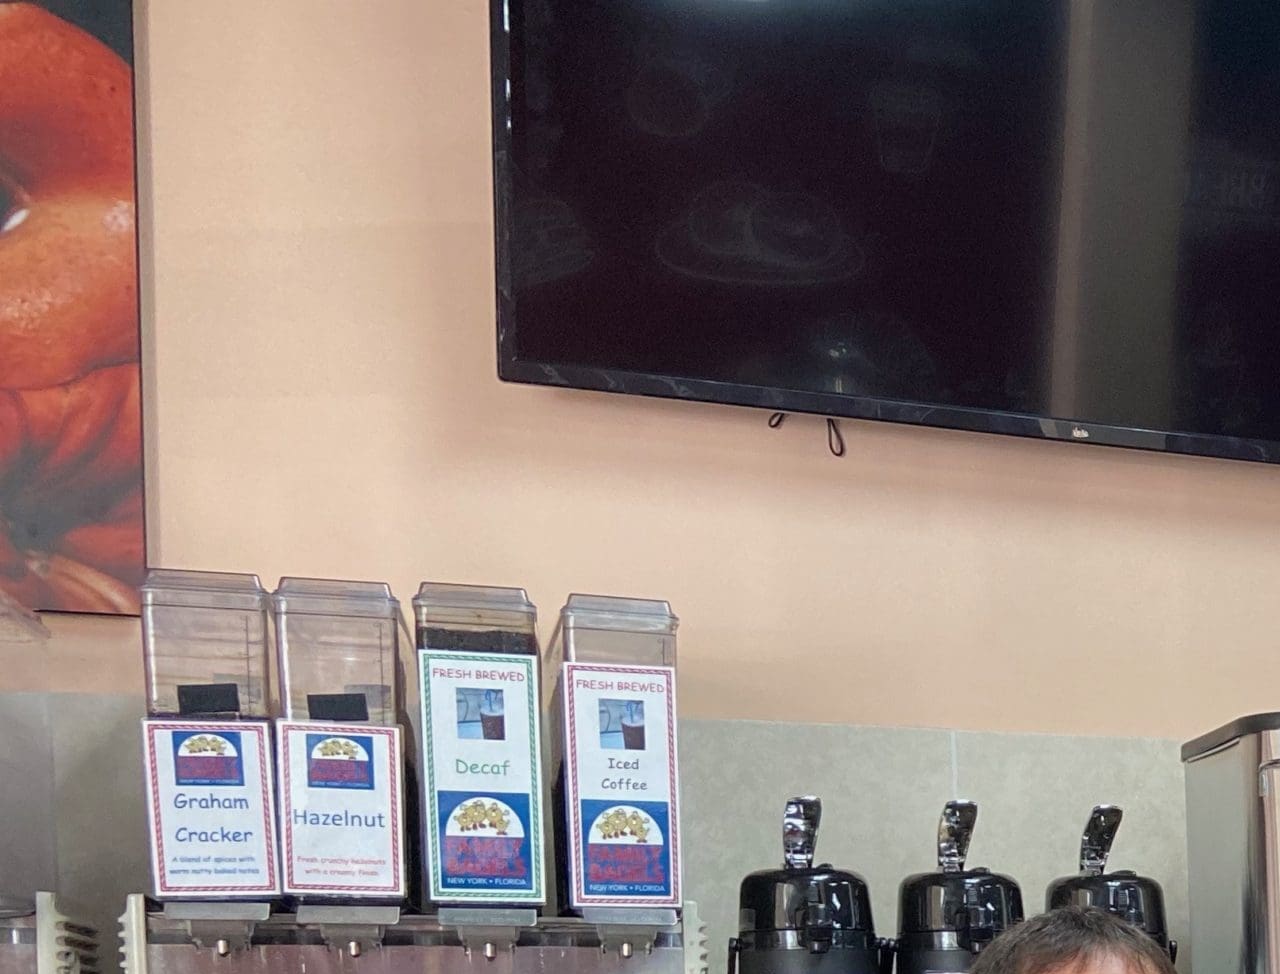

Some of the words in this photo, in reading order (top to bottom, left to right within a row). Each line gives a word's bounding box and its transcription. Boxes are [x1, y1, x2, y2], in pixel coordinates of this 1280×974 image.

[432, 667, 472, 680] FRESH
[475, 669, 525, 682] BREWED
[576, 679, 614, 691] FRESH
[617, 681, 665, 693] BREWED
[455, 758, 510, 776] Decaf
[607, 757, 640, 770] Iced
[601, 777, 648, 791] Coffee
[173, 793, 249, 809] Graham
[293, 808, 386, 828] Hazelnut
[175, 827, 253, 842] Cracker
[447, 877, 466, 885] NEW
[467, 877, 488, 885] YORK
